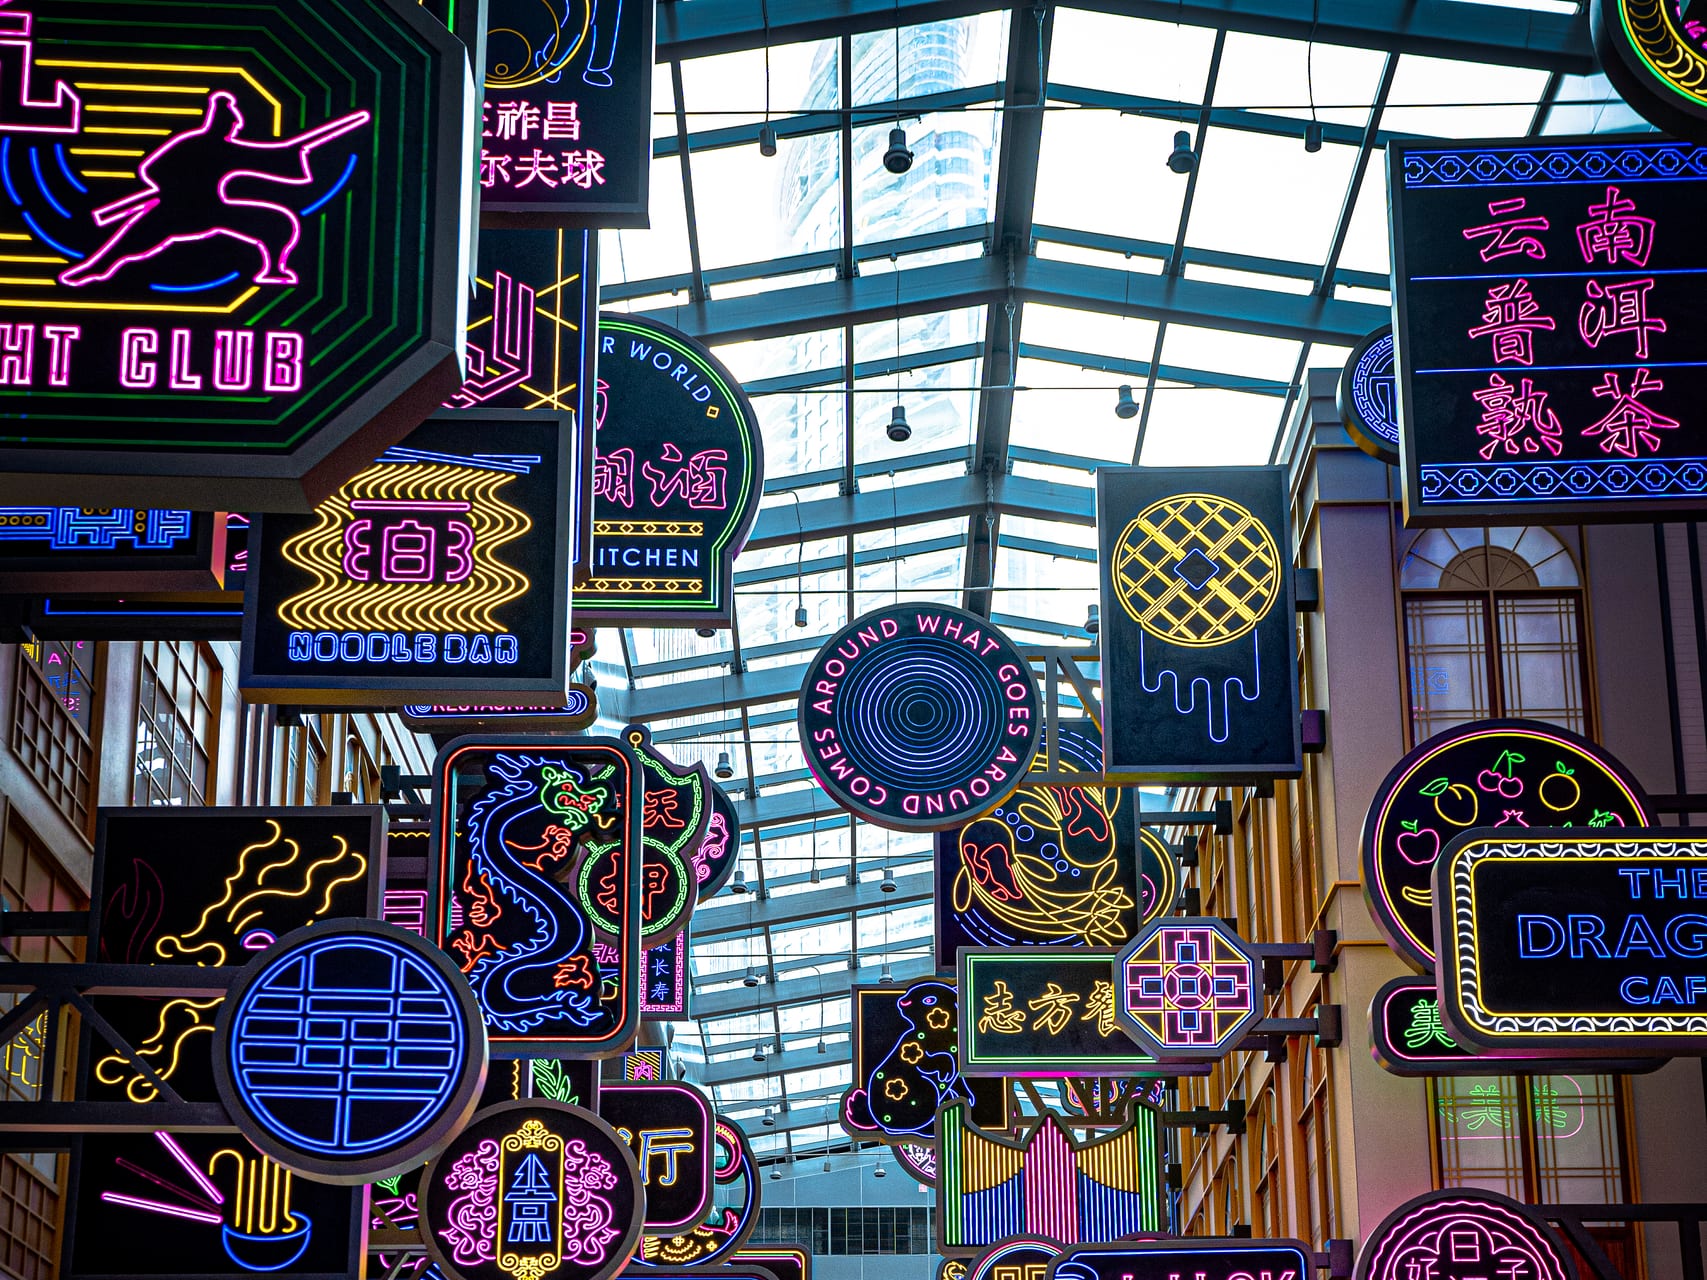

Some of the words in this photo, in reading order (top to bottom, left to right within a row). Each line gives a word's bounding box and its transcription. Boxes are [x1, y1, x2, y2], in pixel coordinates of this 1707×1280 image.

[481, 101, 581, 140] 祚昌
[1463, 187, 1656, 267] 云南
[1468, 278, 1666, 366] 普洱
[120, 328, 304, 392] CLUB
[629, 340, 713, 402] WORLD
[1472, 368, 1679, 461] 熟茶
[288, 631, 437, 663] NOODLE
[443, 633, 519, 664] BAR
[812, 618, 899, 716] AROUND
[917, 614, 1000, 656] WHAT
[998, 664, 1030, 737] GOES
[813, 727, 888, 806] COMES
[902, 745, 1018, 815] AROUND
[1619, 868, 1707, 899] THE
[1620, 976, 1707, 1005] CAF
